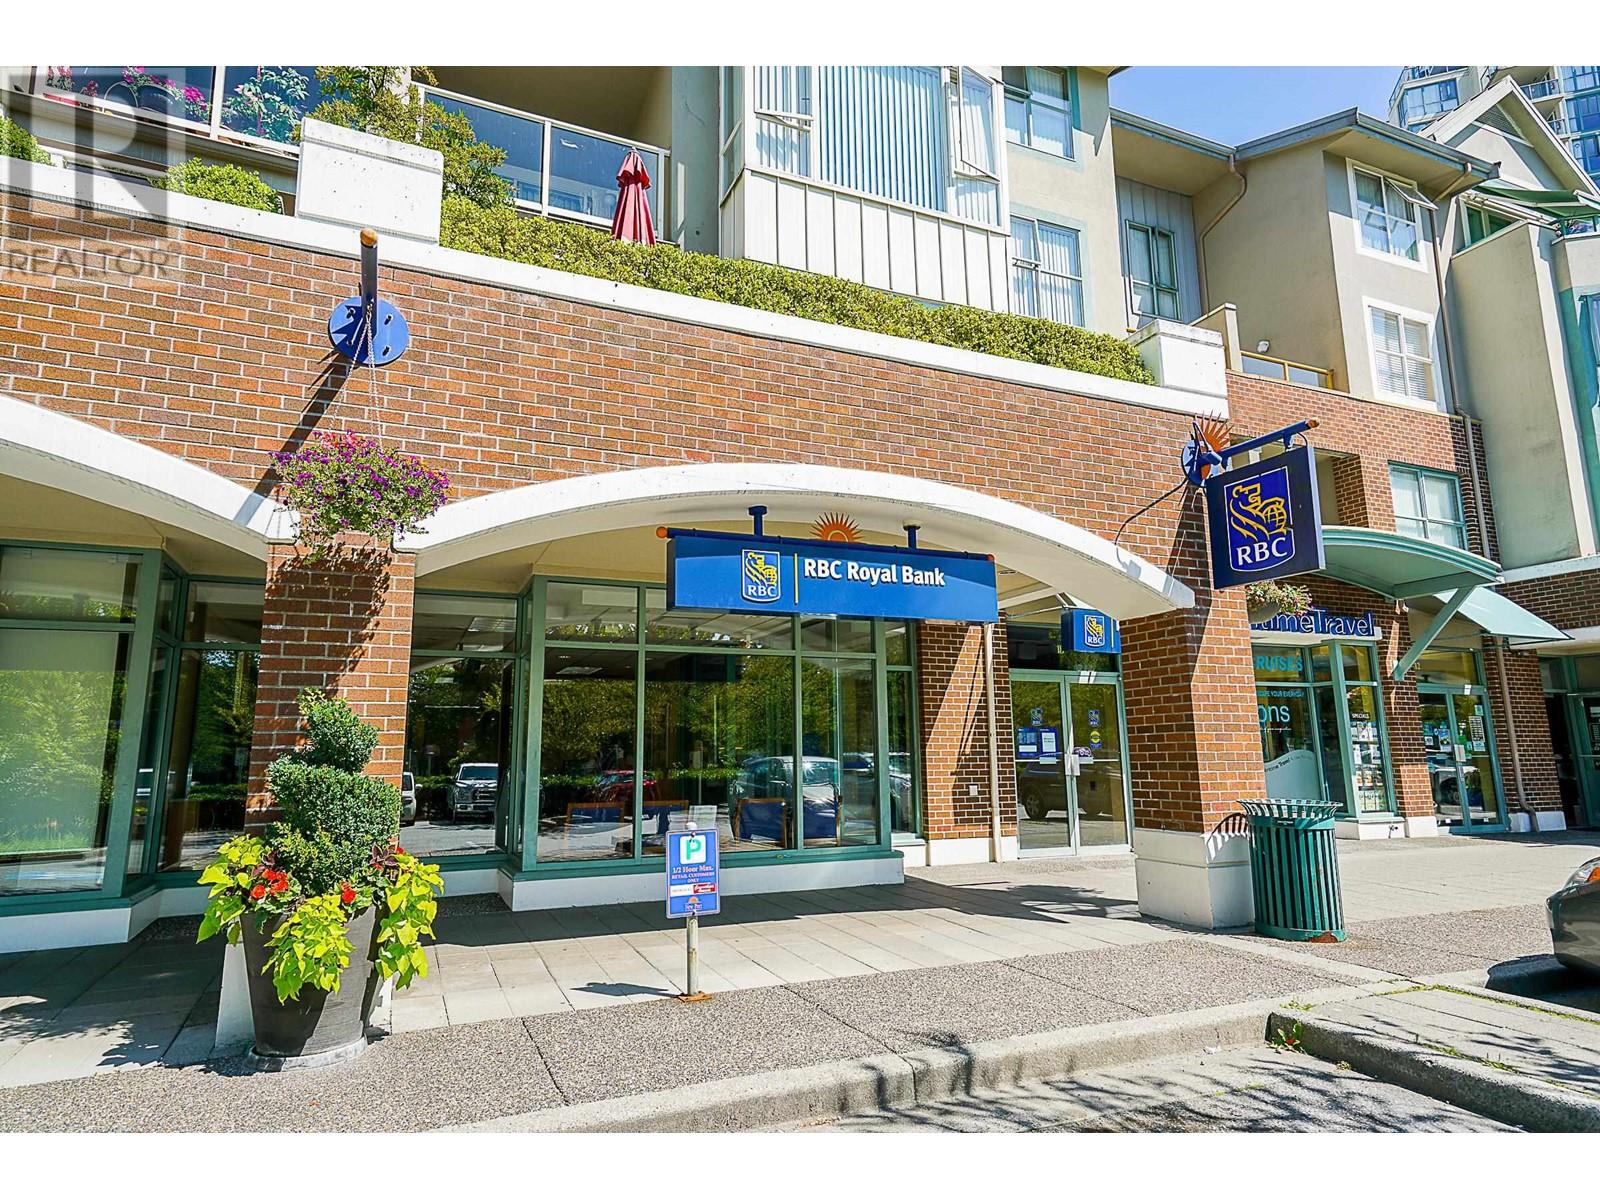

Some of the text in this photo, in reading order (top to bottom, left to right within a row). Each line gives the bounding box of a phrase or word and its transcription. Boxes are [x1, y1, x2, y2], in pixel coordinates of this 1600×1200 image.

[1236, 537, 1288, 566] RBC
[804, 559, 946, 587] RBC Royal Bank
[748, 585, 777, 597] RBC
[1087, 636, 1103, 644] RBC
[1255, 655, 1303, 672] RUISES
[686, 838, 702, 860] P
